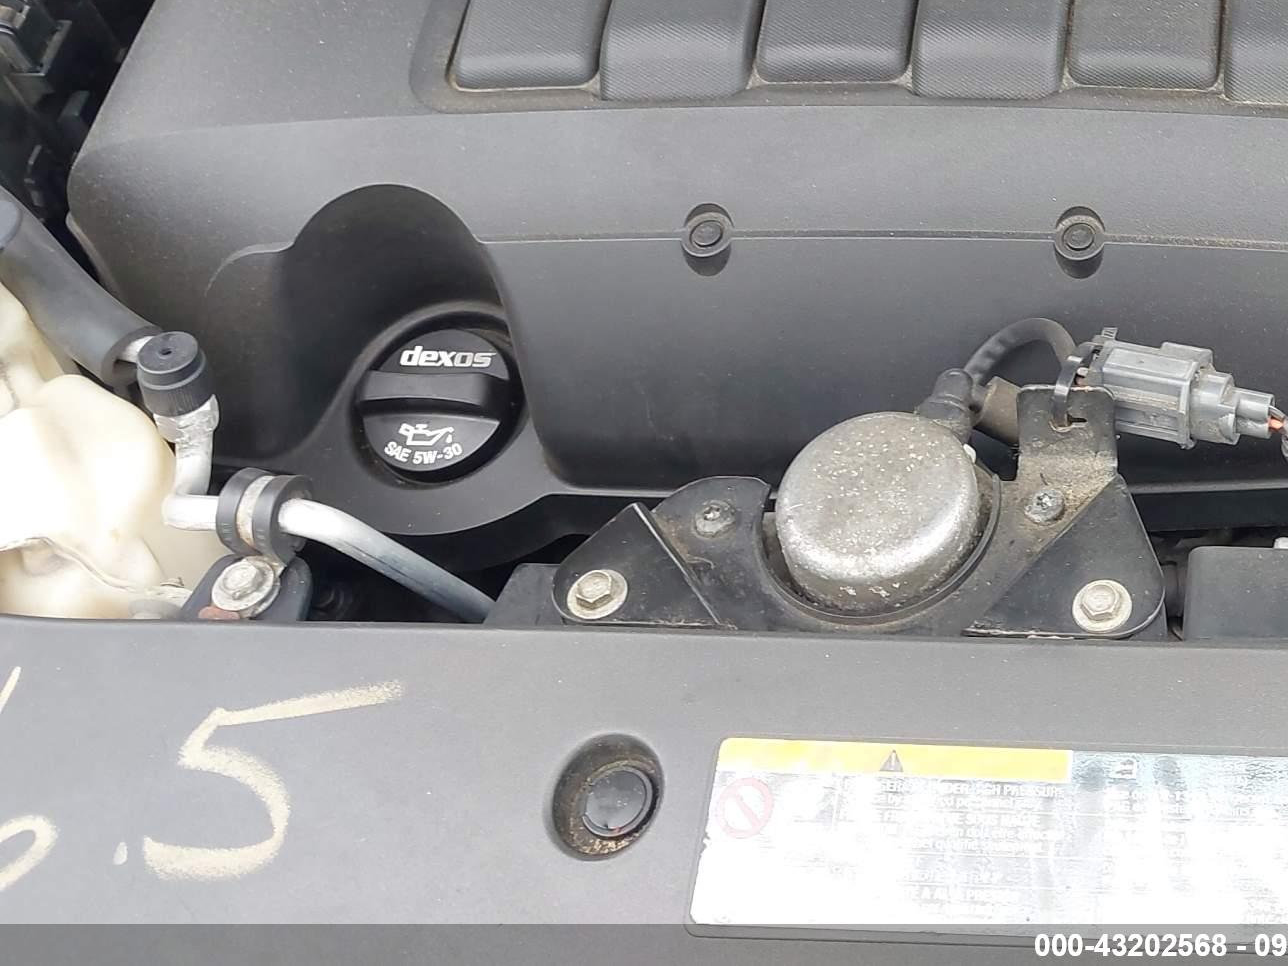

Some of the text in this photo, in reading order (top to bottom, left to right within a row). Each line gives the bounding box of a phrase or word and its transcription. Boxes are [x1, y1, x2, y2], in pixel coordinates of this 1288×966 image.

[399, 345, 497, 368] dexos
[384, 441, 464, 465] SAE 5W-30
